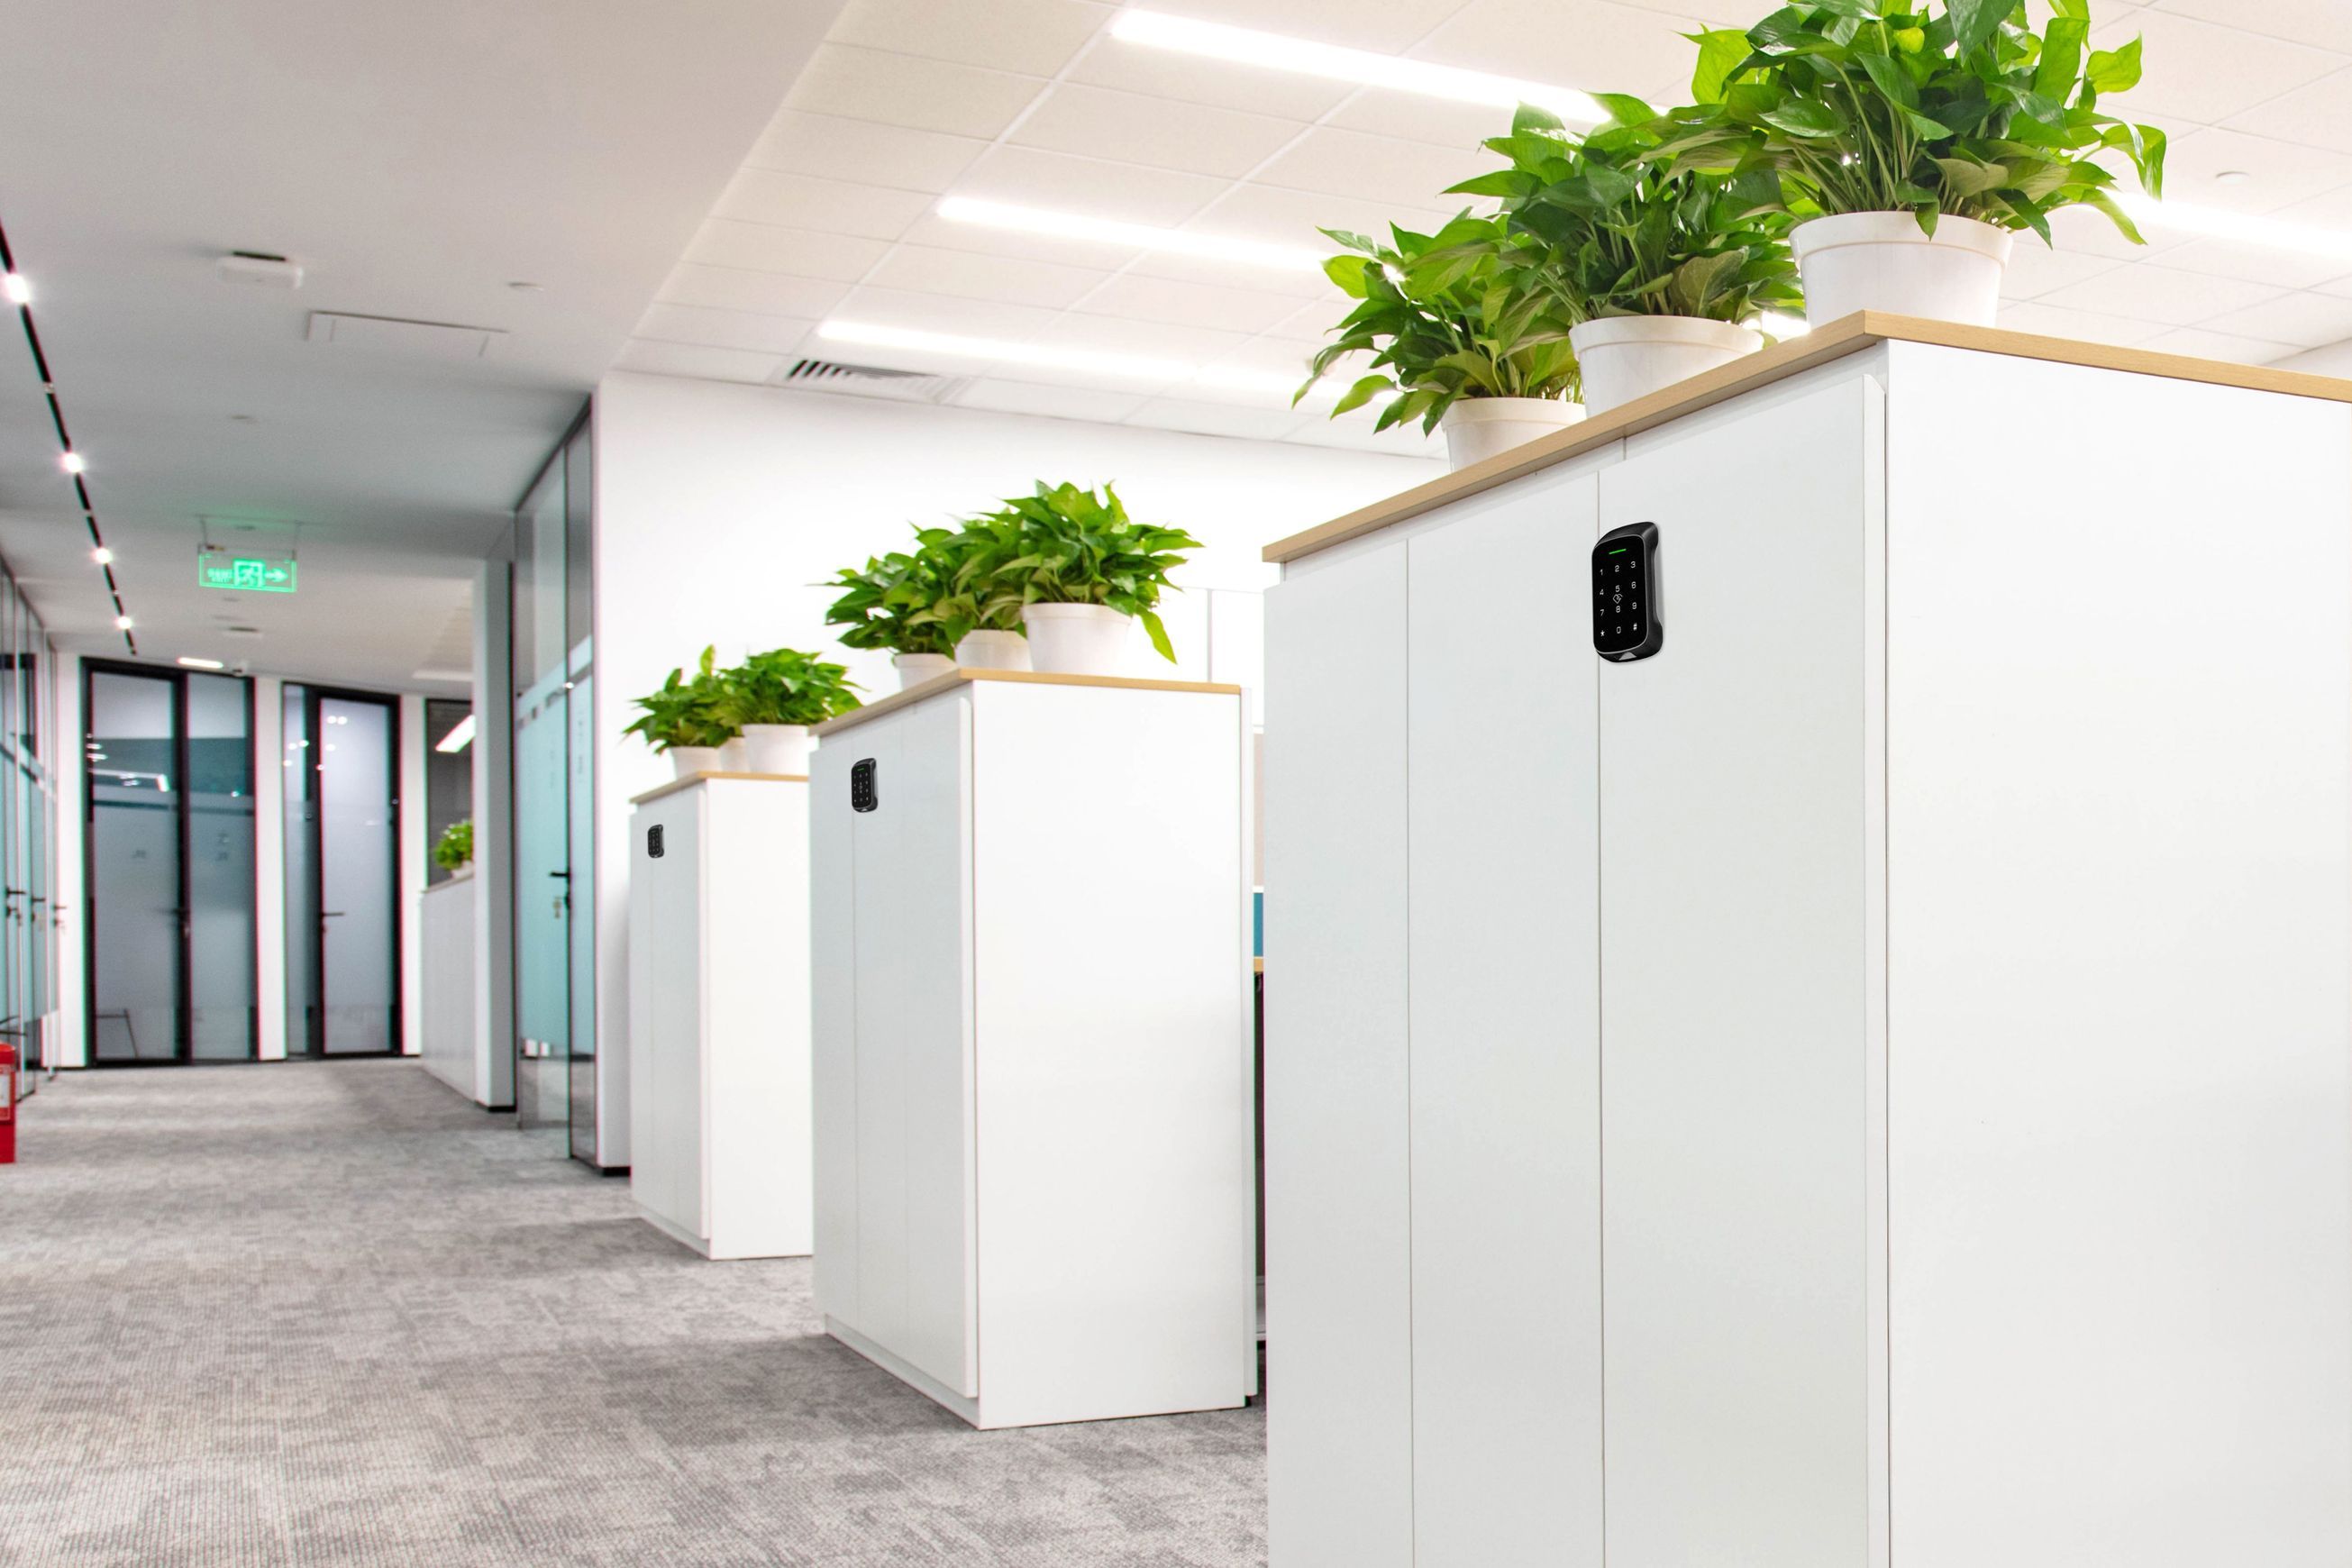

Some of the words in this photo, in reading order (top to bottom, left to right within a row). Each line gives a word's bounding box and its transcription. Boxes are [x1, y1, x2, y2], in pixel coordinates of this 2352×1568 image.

[1614, 564, 1620, 572] 2
[1630, 561, 1636, 569] 3
[1615, 585, 1620, 593] 5
[1631, 581, 1636, 589] 6
[1600, 608, 1605, 616] 7
[1615, 605, 1621, 614] 8
[1632, 602, 1637, 610] 9
[1616, 626, 1621, 634] 0
[1633, 623, 1637, 631] #
